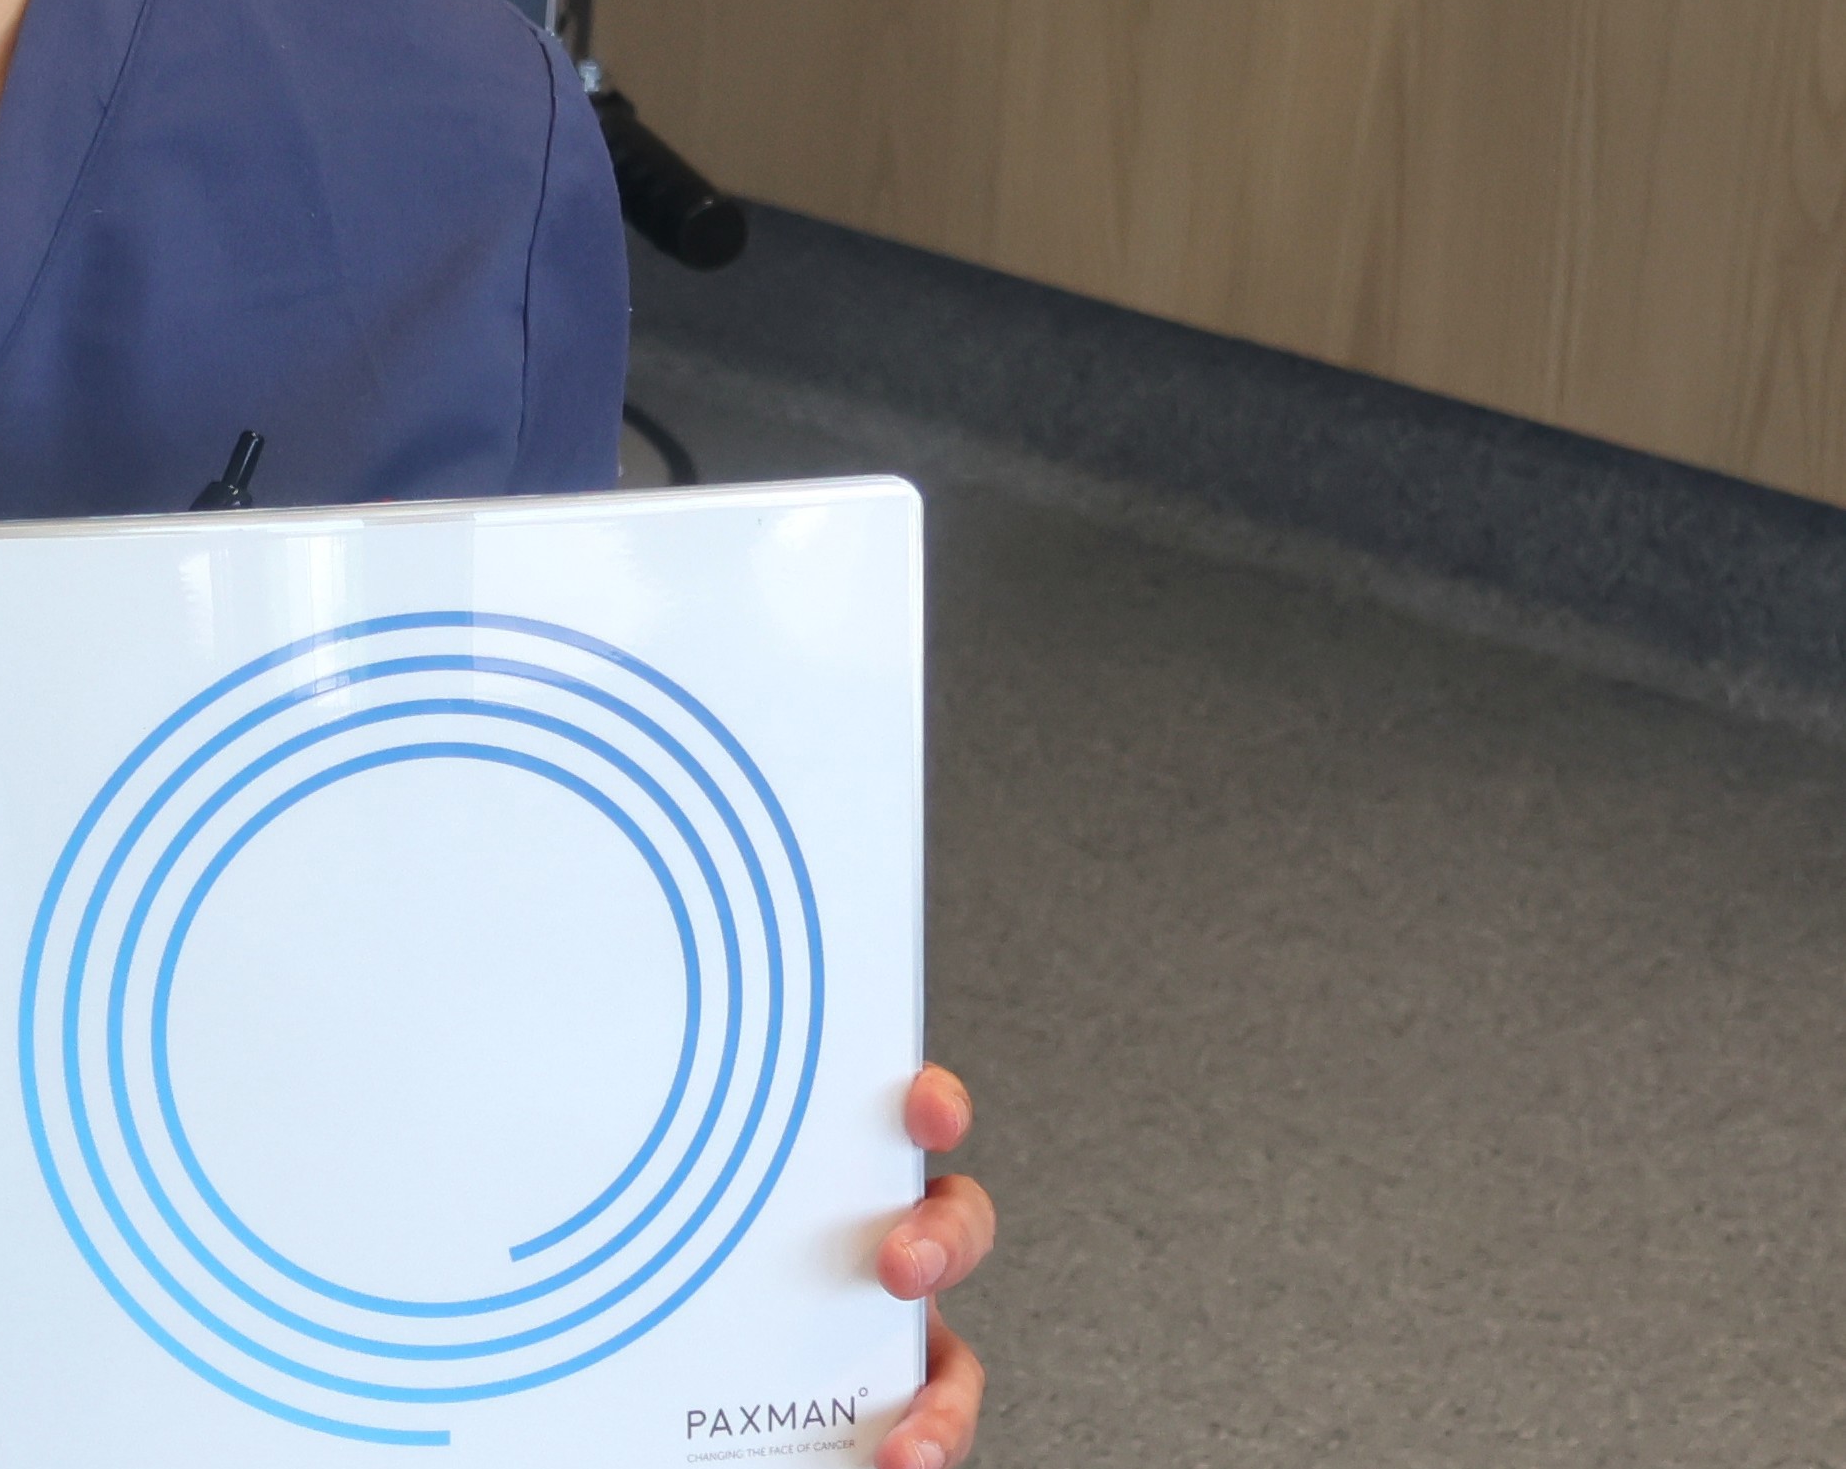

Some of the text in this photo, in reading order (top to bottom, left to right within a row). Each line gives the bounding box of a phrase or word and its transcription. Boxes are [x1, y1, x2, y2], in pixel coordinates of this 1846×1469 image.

[686, 1439, 856, 1463] CHANGING THE FACE OF CANCER
